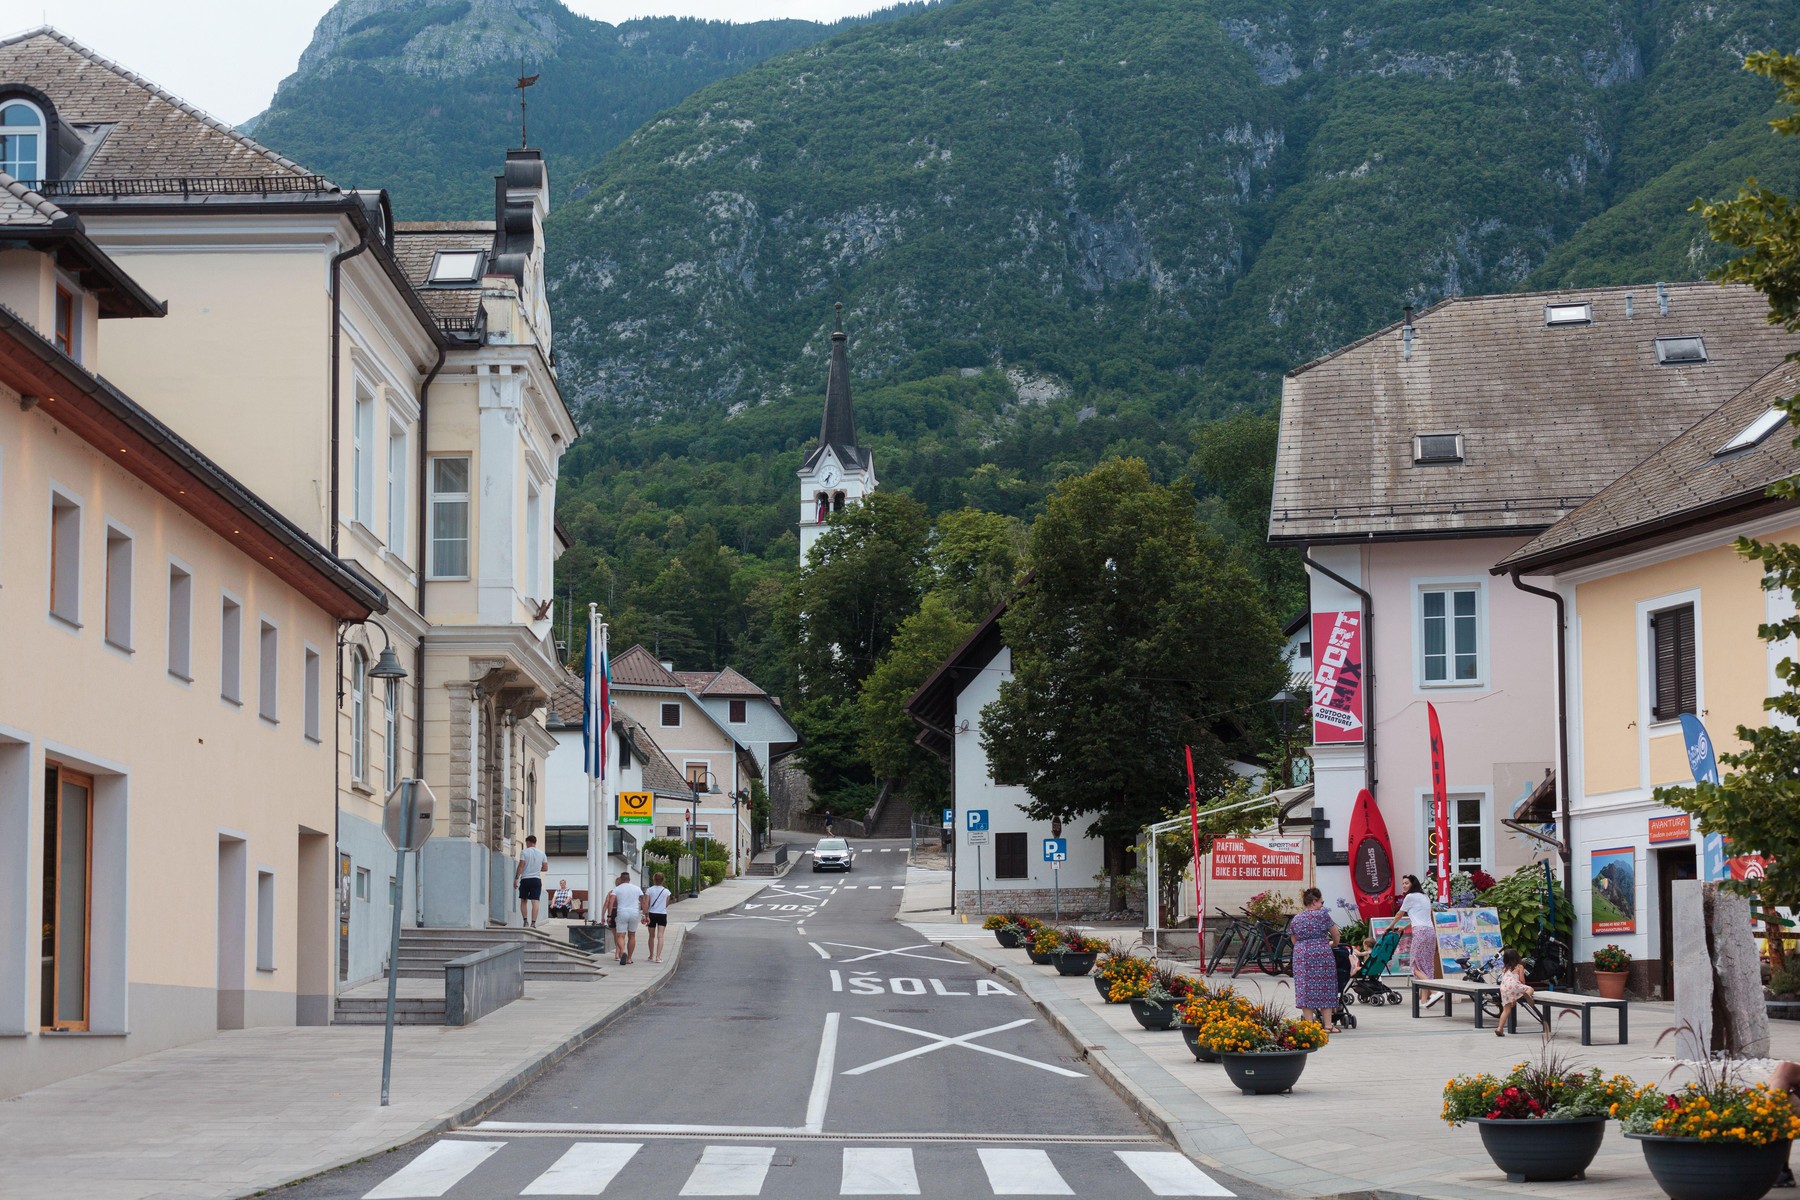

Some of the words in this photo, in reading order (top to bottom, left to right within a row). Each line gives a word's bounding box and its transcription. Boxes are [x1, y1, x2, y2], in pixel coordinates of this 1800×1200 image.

[1312, 611, 1359, 705] SPORT
[1329, 657, 1362, 711] MIX
[1315, 713, 1352, 726] ADVENTURES
[1320, 708, 1351, 720] OUTDOOR
[969, 812, 981, 827] P
[1651, 818, 1686, 830] AVANTURA
[1045, 841, 1058, 858] P
[1216, 842, 1246, 852] RAFTING,
[1215, 855, 1236, 864] KAYAK
[1237, 854, 1258, 865] TRIPS,
[1261, 855, 1302, 866] CANYONING,
[1367, 847, 1379, 887] SPORTMIX
[1215, 867, 1231, 877] BIKE
[1232, 867, 1237, 877] &
[1239, 867, 1260, 877] E-BIKE
[1262, 867, 1287, 877] RENTAL
[848, 971, 1018, 996] ŠOLA
